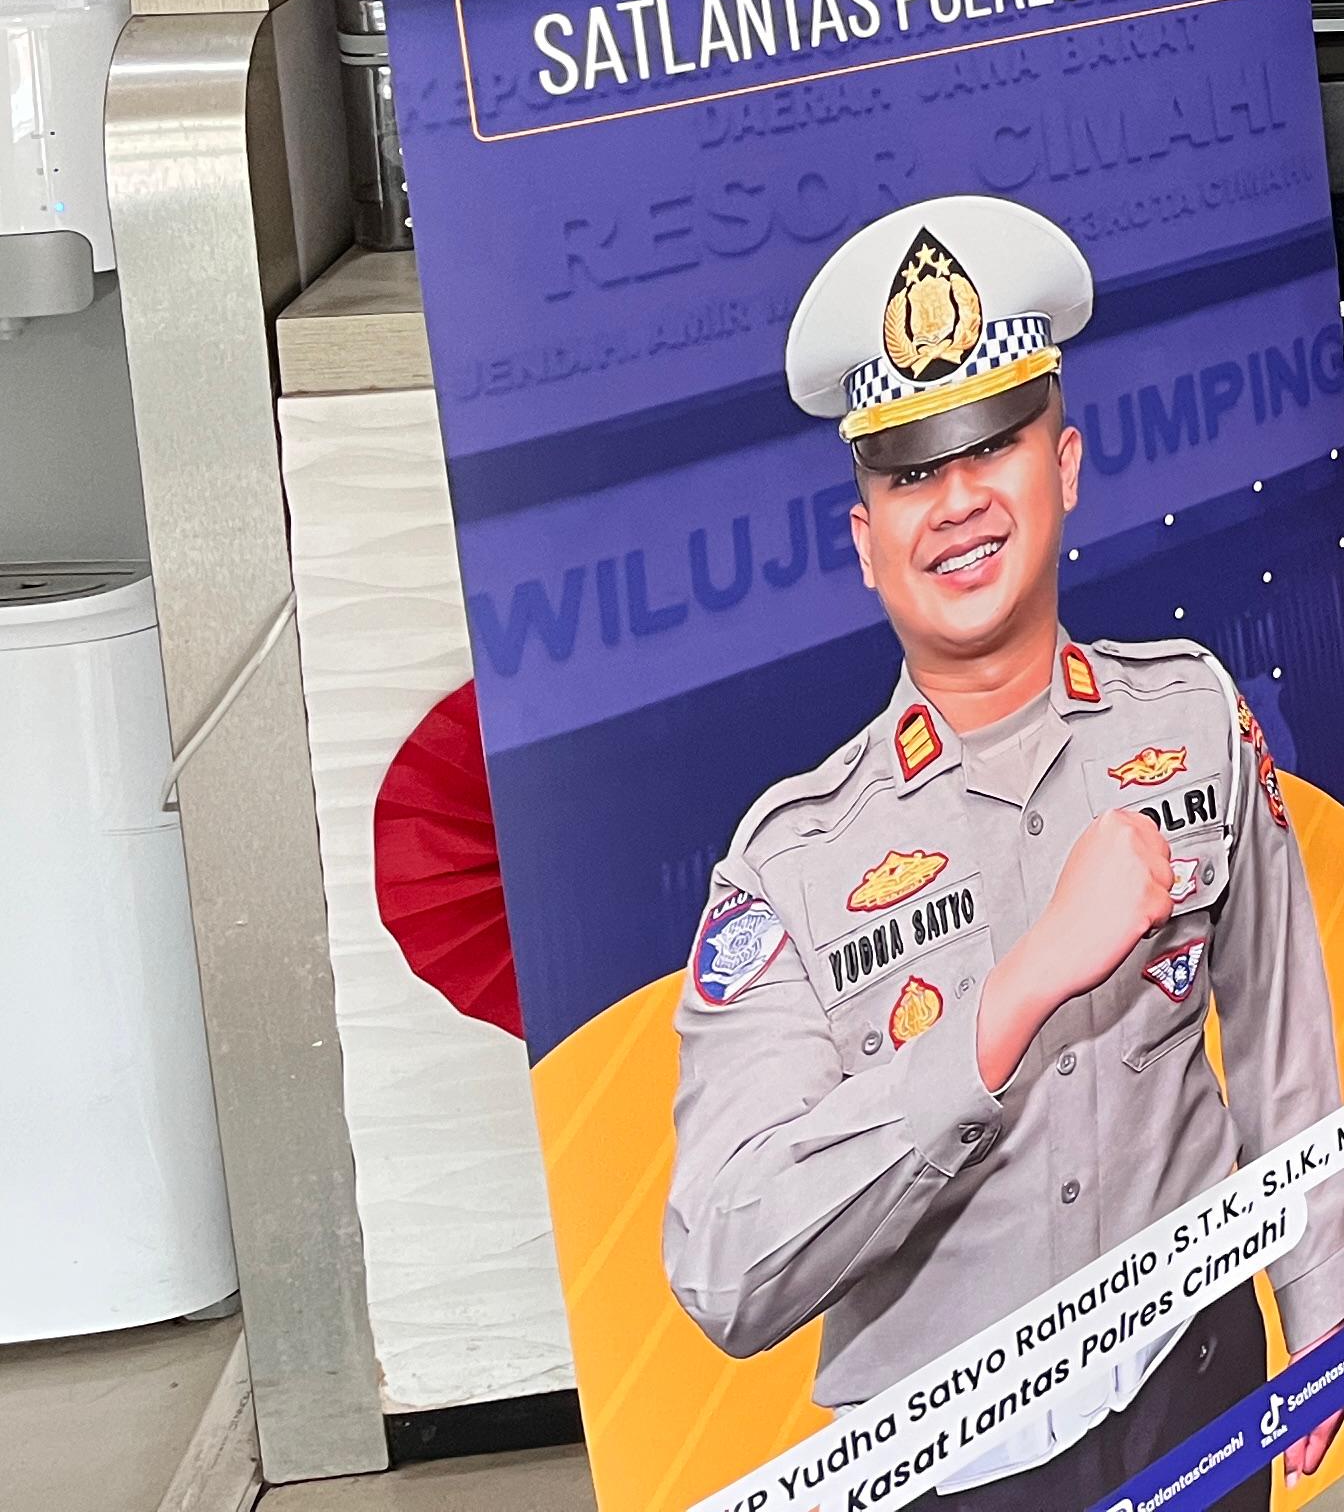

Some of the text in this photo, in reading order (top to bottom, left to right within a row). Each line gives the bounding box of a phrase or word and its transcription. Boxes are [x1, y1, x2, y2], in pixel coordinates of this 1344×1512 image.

[828, 888, 975, 991] YUDHA SATYO
[778, 1413, 897, 1500] Yudha
[907, 1348, 1006, 1422] Satyo
[846, 1207, 1287, 1512] Kasat Lantas Polres Cimahi
